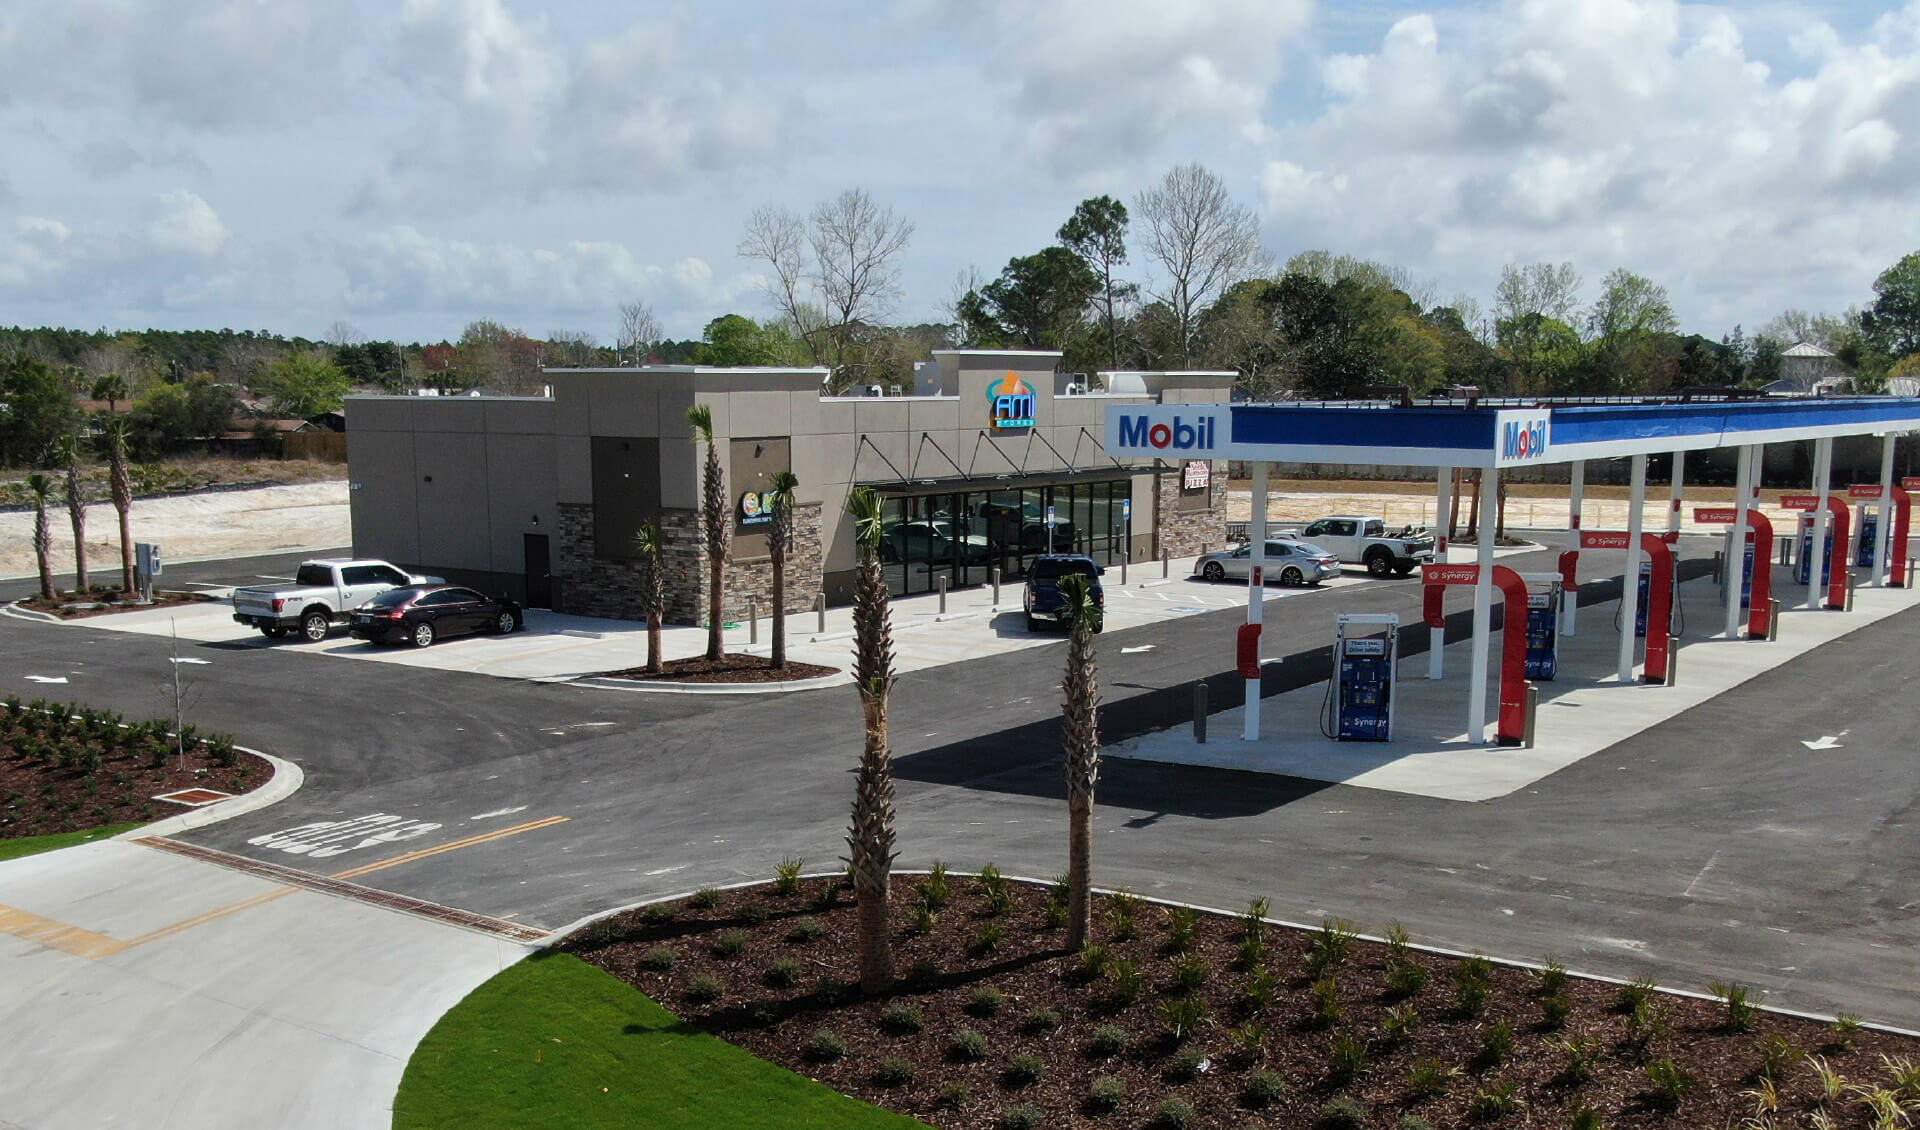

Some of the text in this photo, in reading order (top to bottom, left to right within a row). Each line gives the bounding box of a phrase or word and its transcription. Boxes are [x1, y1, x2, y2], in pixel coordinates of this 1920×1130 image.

[1119, 415, 1215, 449] Mobil
[1503, 420, 1546, 457] Mobil
[1597, 538, 1627, 546] Synergy
[1441, 571, 1476, 581] Synergy
[1524, 660, 1552, 669] Synegy
[1354, 718, 1387, 728] Synergy
[247, 812, 443, 858] STOP
